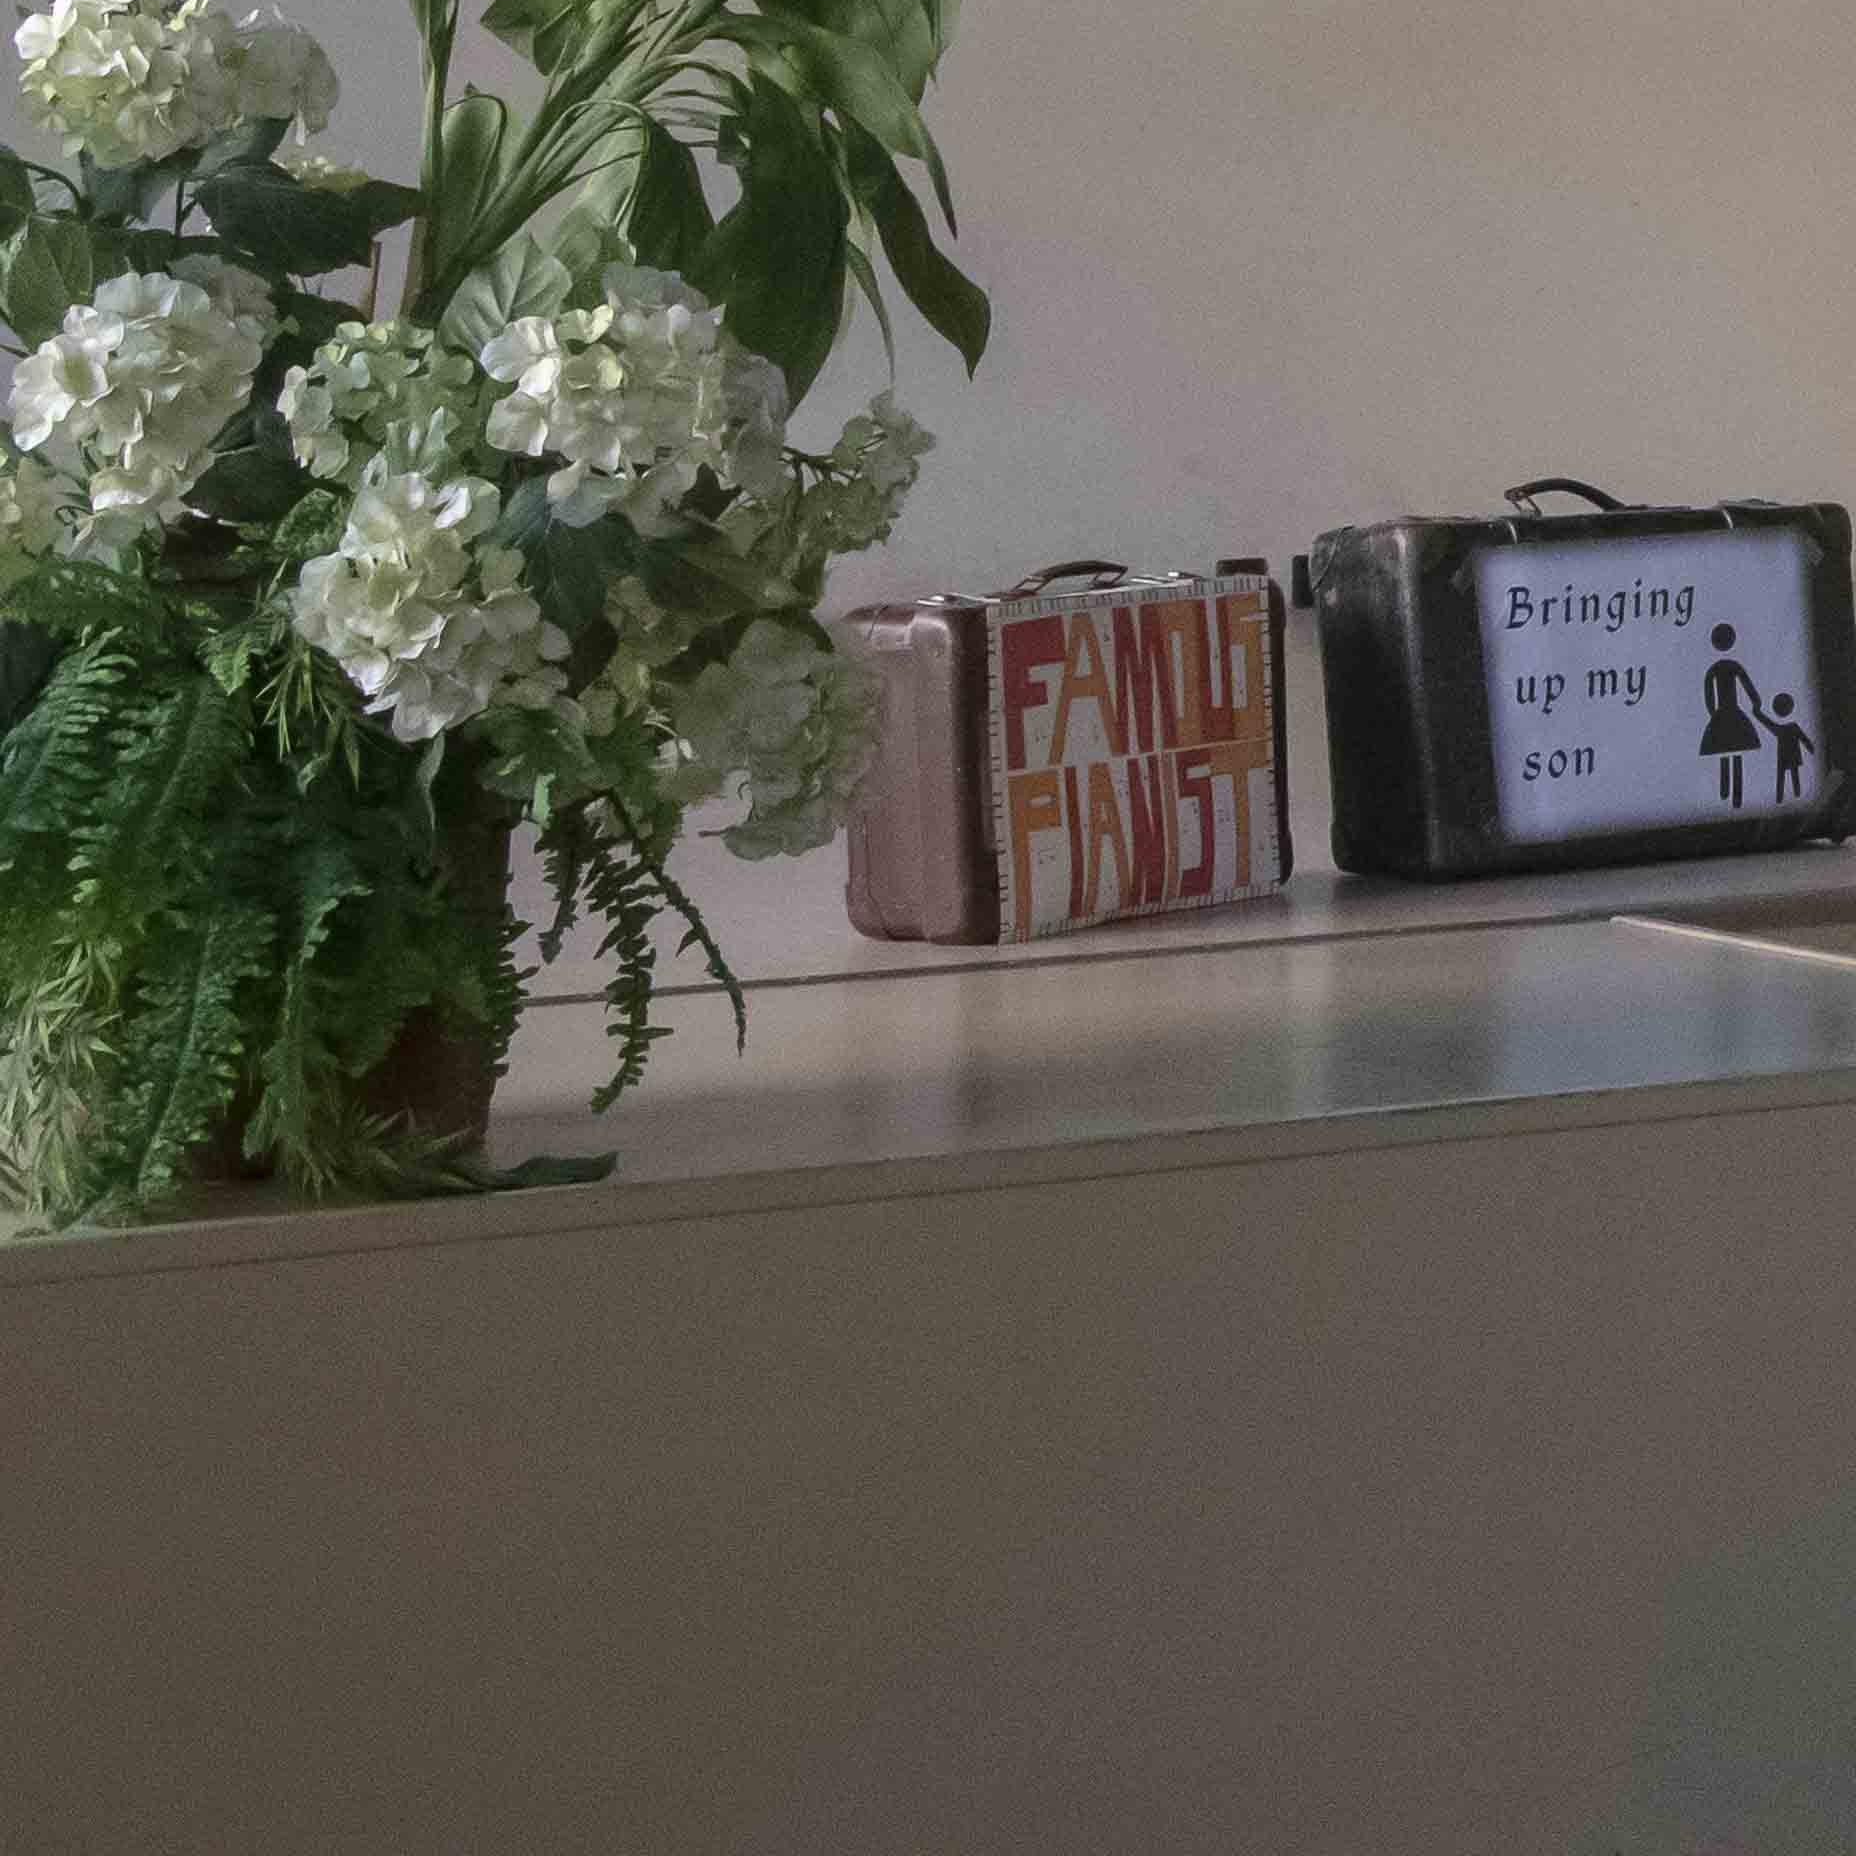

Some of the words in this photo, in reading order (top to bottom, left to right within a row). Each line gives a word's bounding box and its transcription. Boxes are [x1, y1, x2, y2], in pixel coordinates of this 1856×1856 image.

[1505, 578, 1695, 633] Bringing
[1001, 591, 1268, 771] FAMOUS
[1515, 673, 1565, 714] up
[1586, 665, 1648, 706] my
[1521, 746, 1596, 782] son
